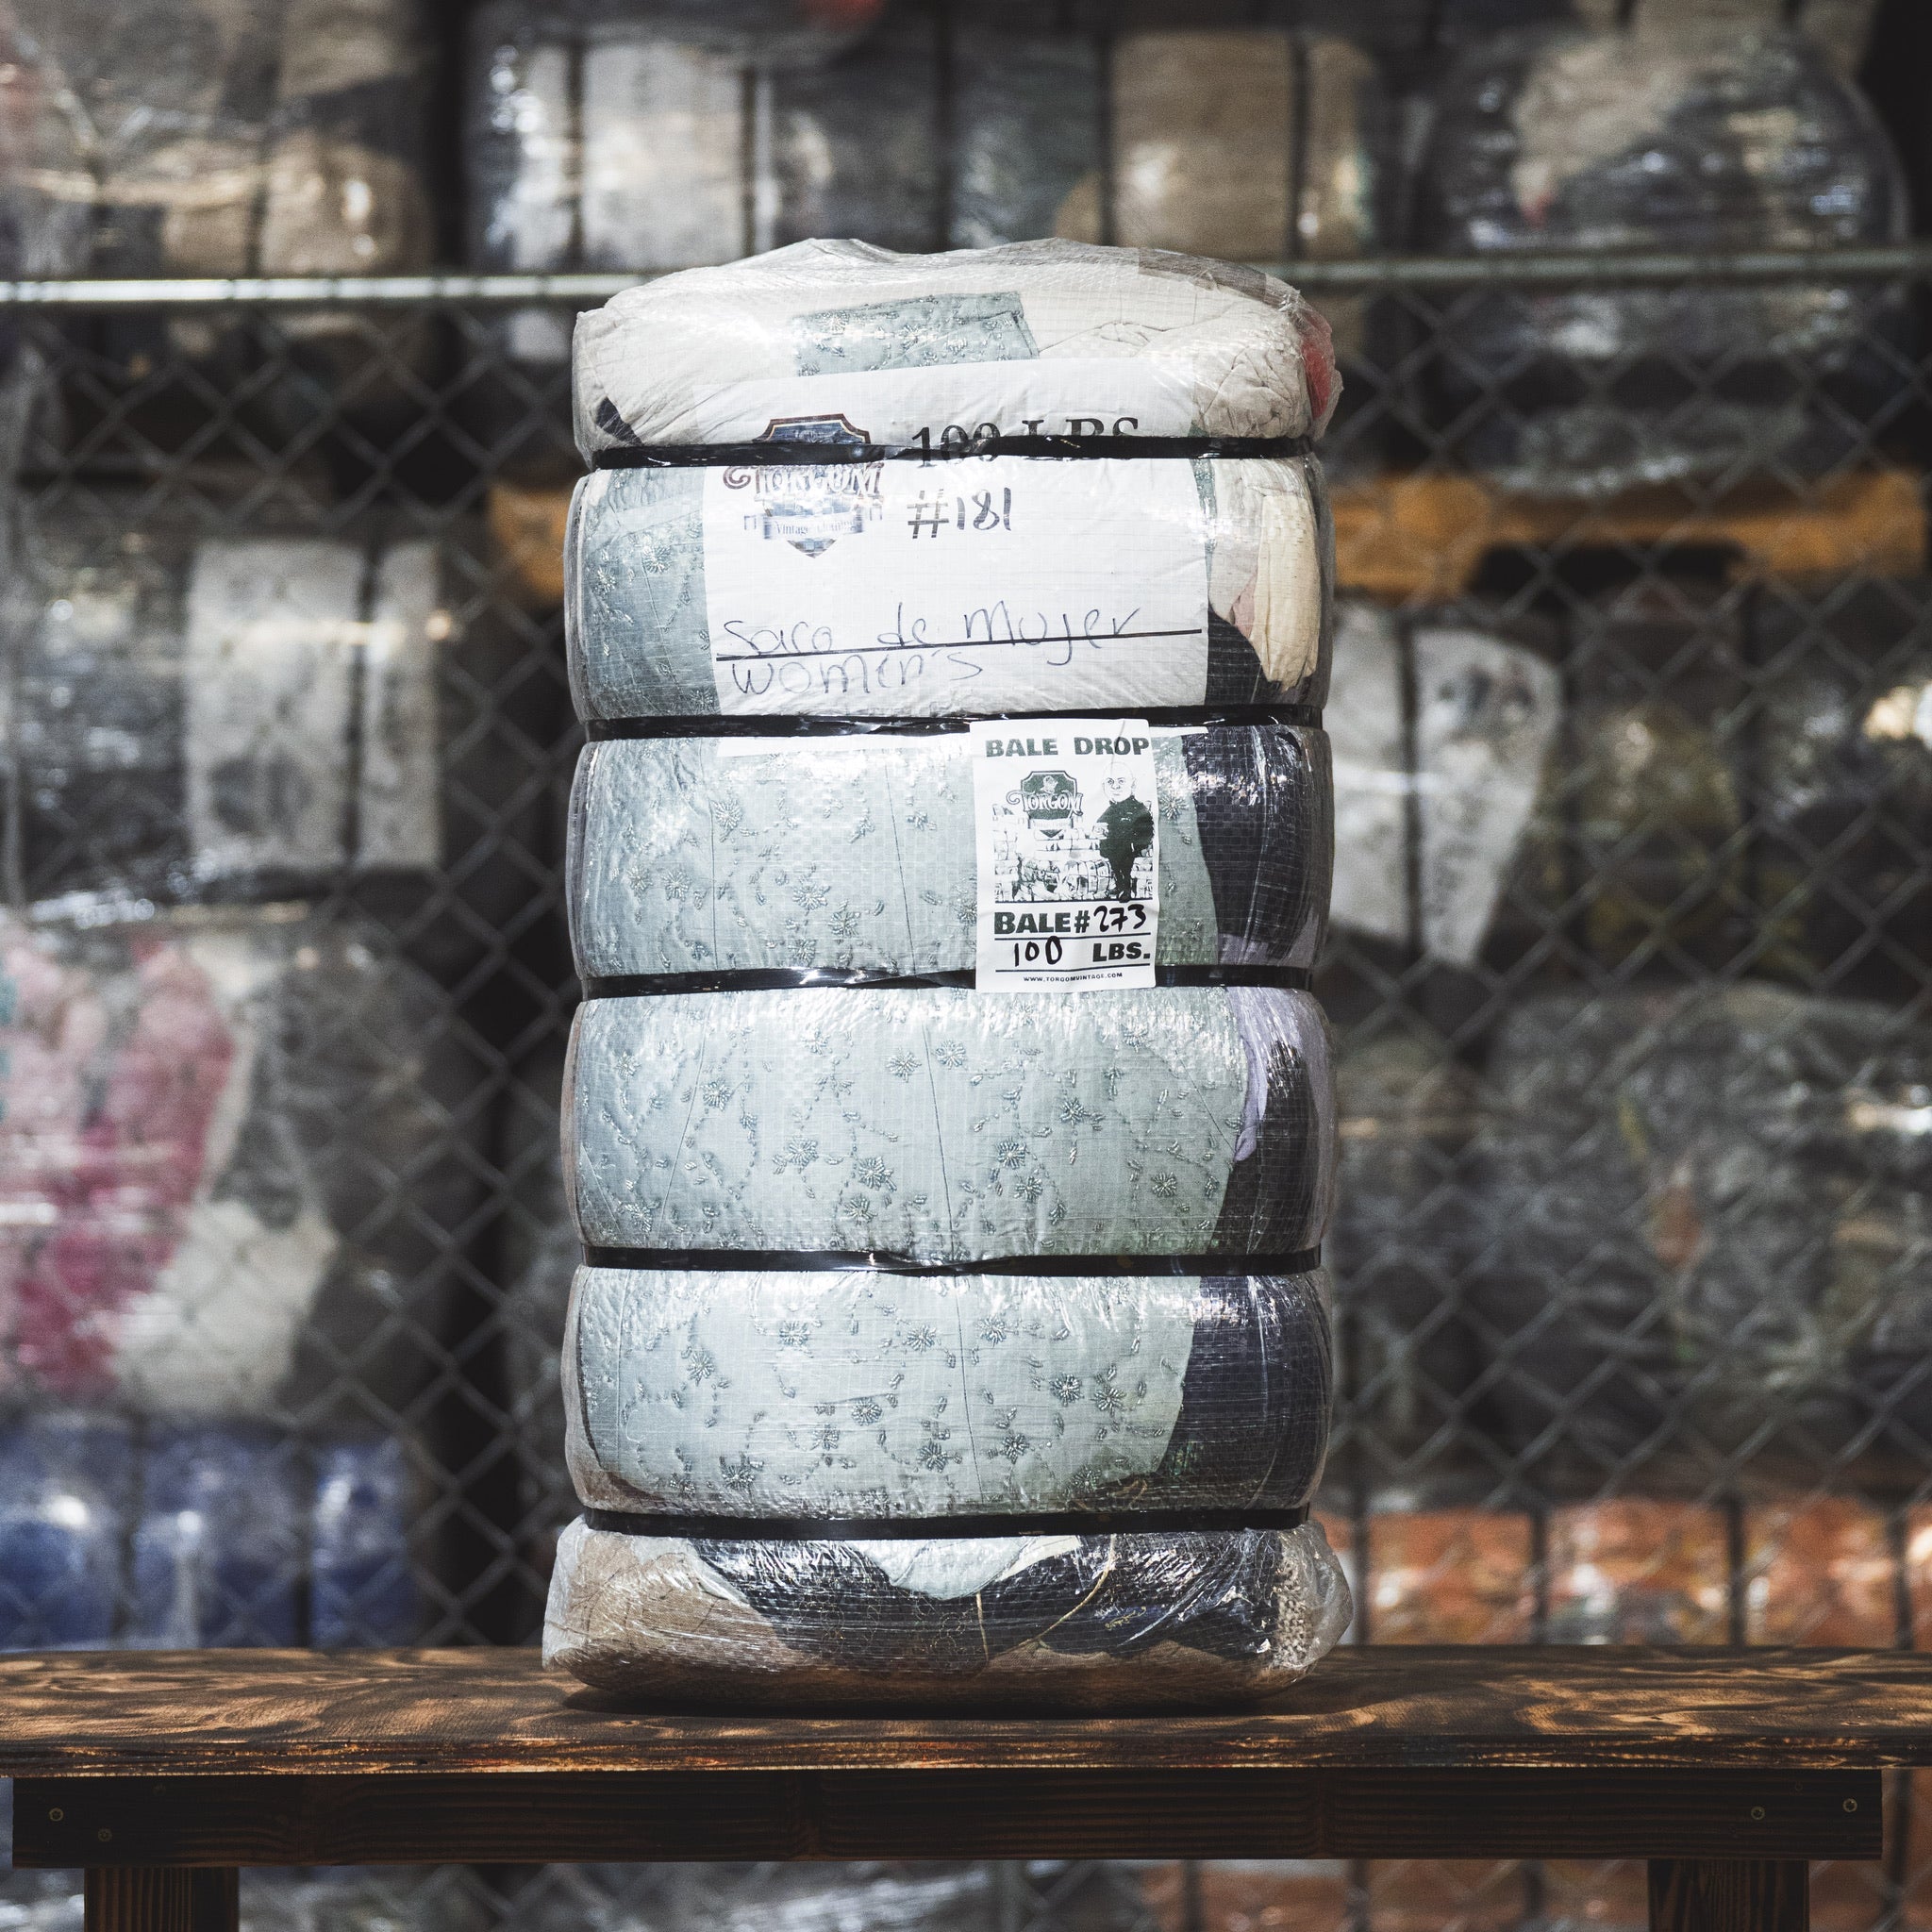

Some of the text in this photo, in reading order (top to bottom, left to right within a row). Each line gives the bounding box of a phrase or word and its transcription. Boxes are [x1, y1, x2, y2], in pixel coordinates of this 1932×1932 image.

[907, 487, 1012, 540] #181
[774, 520, 814, 536] Vintag
[877, 602, 936, 647] de
[985, 737, 1150, 758] BALE DROP
[1006, 790, 1084, 816] TORGOM
[1013, 936, 1151, 967] 100 LBS.
[1023, 972, 1123, 983] WWW.TORGOMVINTAGE.COM
